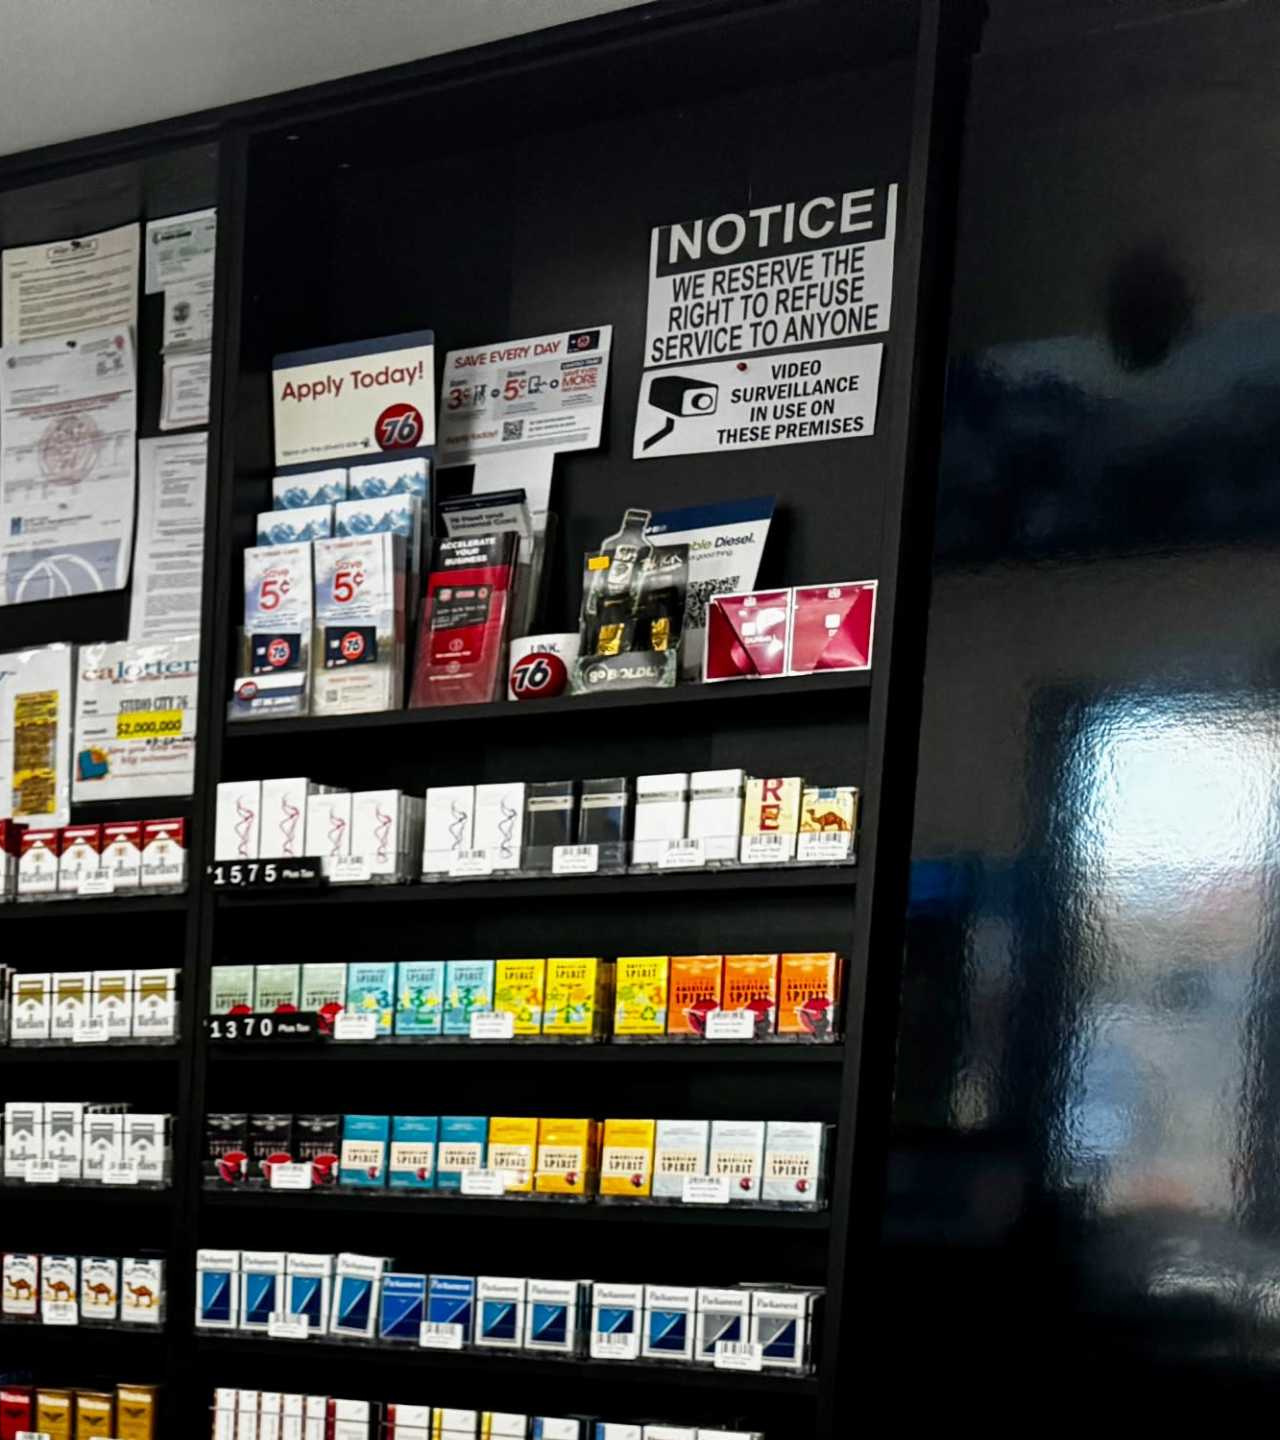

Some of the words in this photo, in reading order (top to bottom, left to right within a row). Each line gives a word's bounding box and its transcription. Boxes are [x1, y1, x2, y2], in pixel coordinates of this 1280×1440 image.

[669, 188, 875, 264] NOTICE
[672, 273, 705, 302] WE
[711, 255, 814, 296] RESERVE
[822, 246, 865, 277] THE
[668, 297, 733, 332] RIGHT
[740, 292, 768, 320] TO
[775, 276, 865, 315] REFUSE
[651, 325, 742, 362] SERVICE
[749, 320, 778, 348] TO
[783, 304, 879, 343] ANYONE
[455, 352, 486, 369] SAVE
[490, 346, 531, 363] EVERY
[534, 341, 561, 358] DAY
[771, 360, 821, 380] VIDEO
[281, 375, 343, 401] Apply
[350, 361, 424, 390] Today!
[730, 375, 859, 403] SURVEILLANCE
[749, 406, 768, 422] IN
[772, 403, 806, 420] USE
[810, 399, 835, 416] ON
[381, 414, 415, 446] 76
[717, 426, 771, 445] THESE
[775, 416, 864, 439] PREMISES
[513, 661, 550, 692] 76
